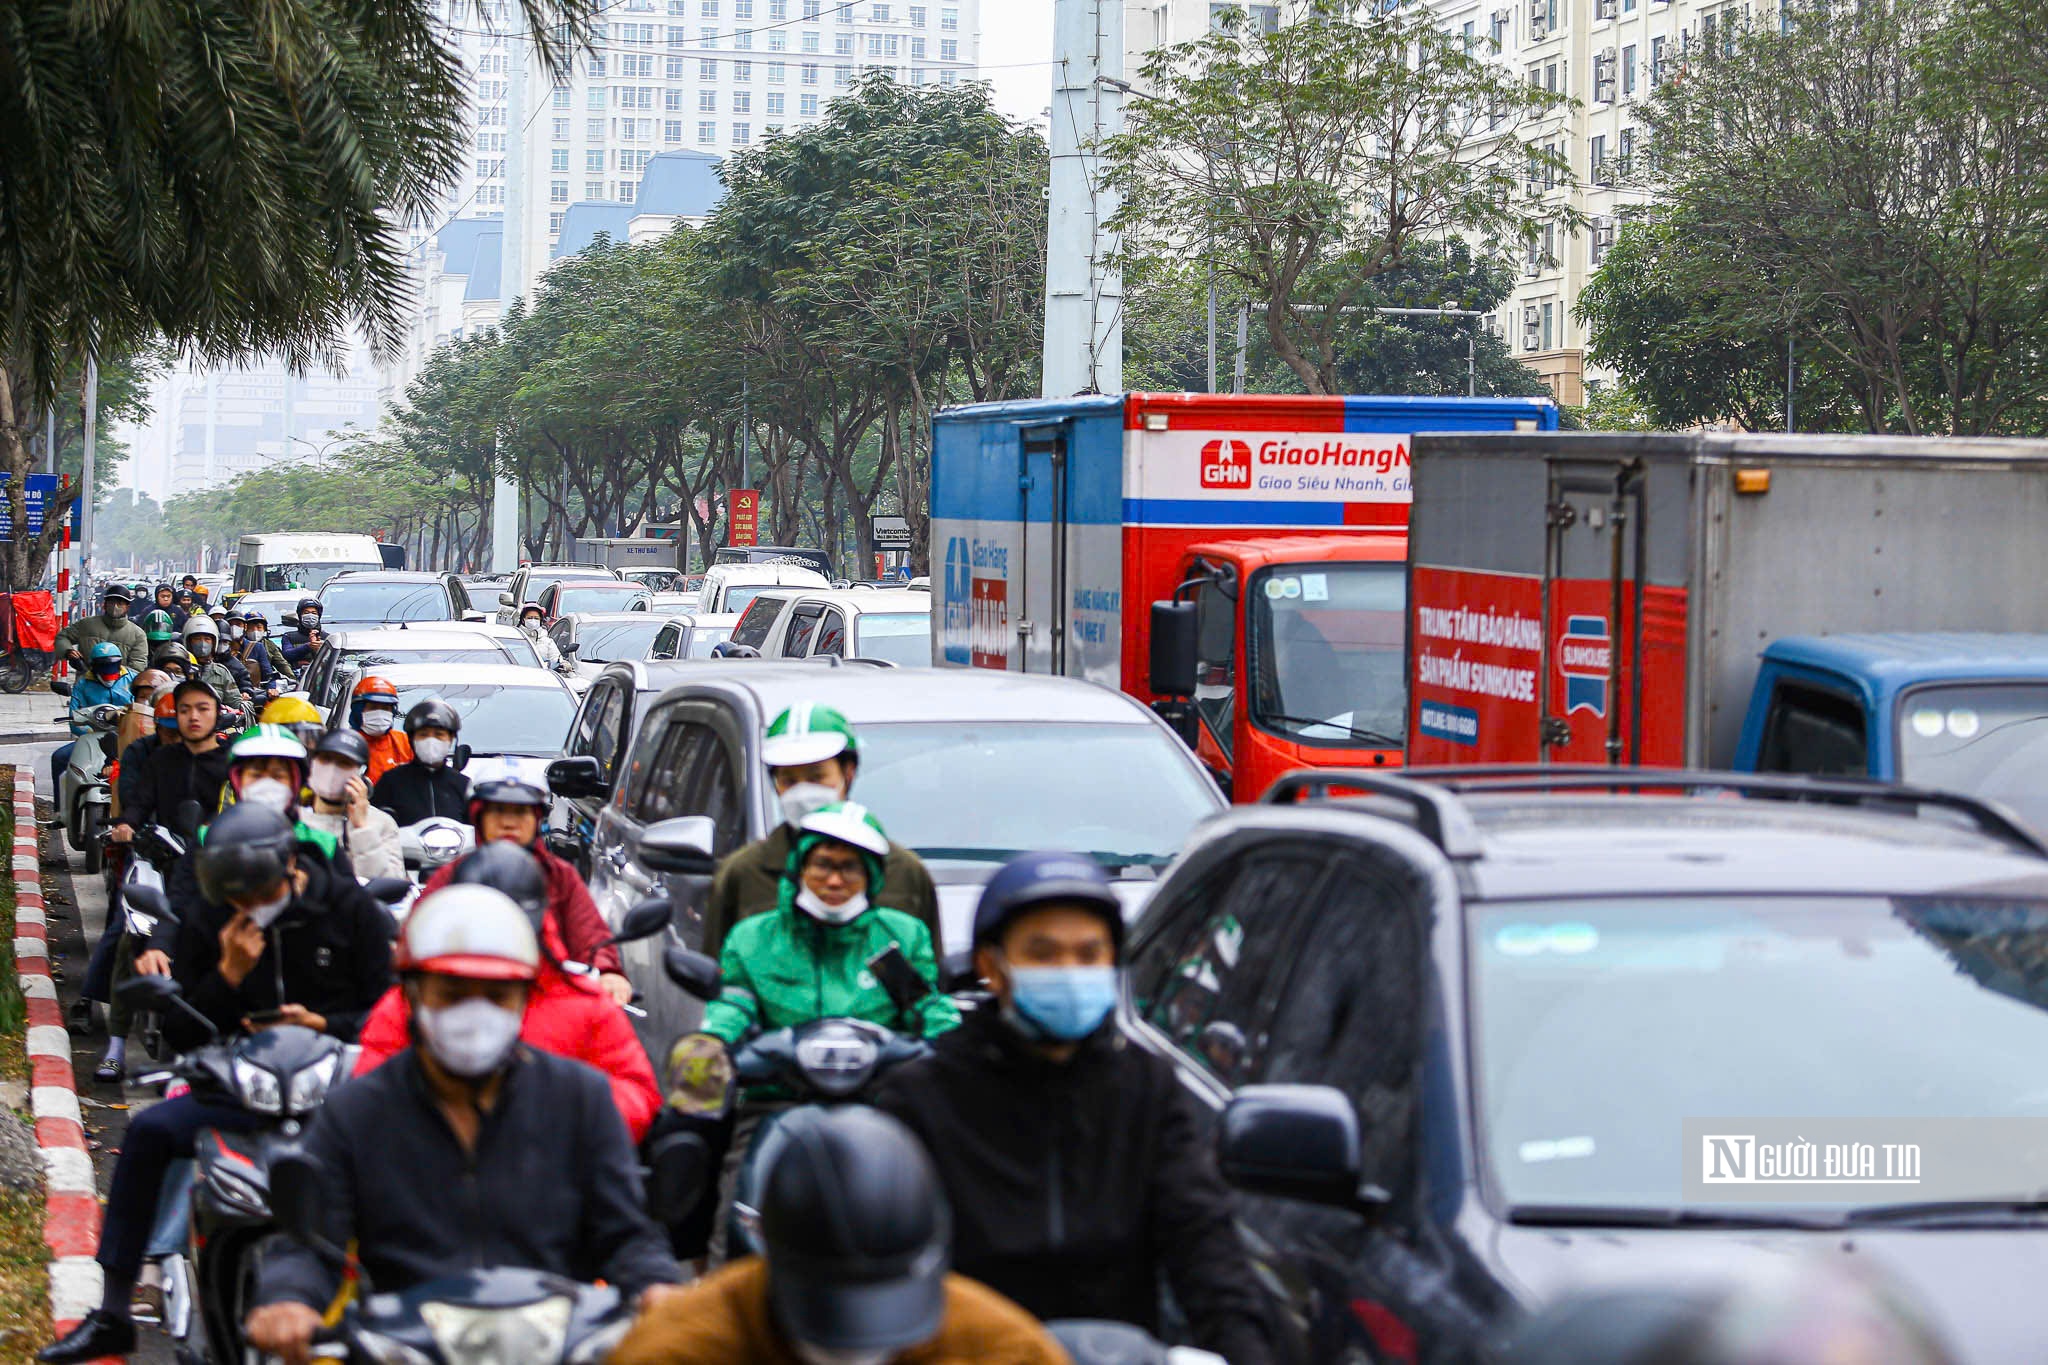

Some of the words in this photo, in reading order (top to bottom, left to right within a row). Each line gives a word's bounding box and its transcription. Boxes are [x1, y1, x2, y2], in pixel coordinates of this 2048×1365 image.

[1259, 441, 1411, 474] GiaoHangN
[1204, 464, 1248, 483] GHN
[1258, 475, 1293, 490] Giao
[1419, 606, 1453, 639] TRUNG
[1563, 645, 1611, 668] SUNHOUSE
[1471, 661, 1536, 703] SUNHOUSE
